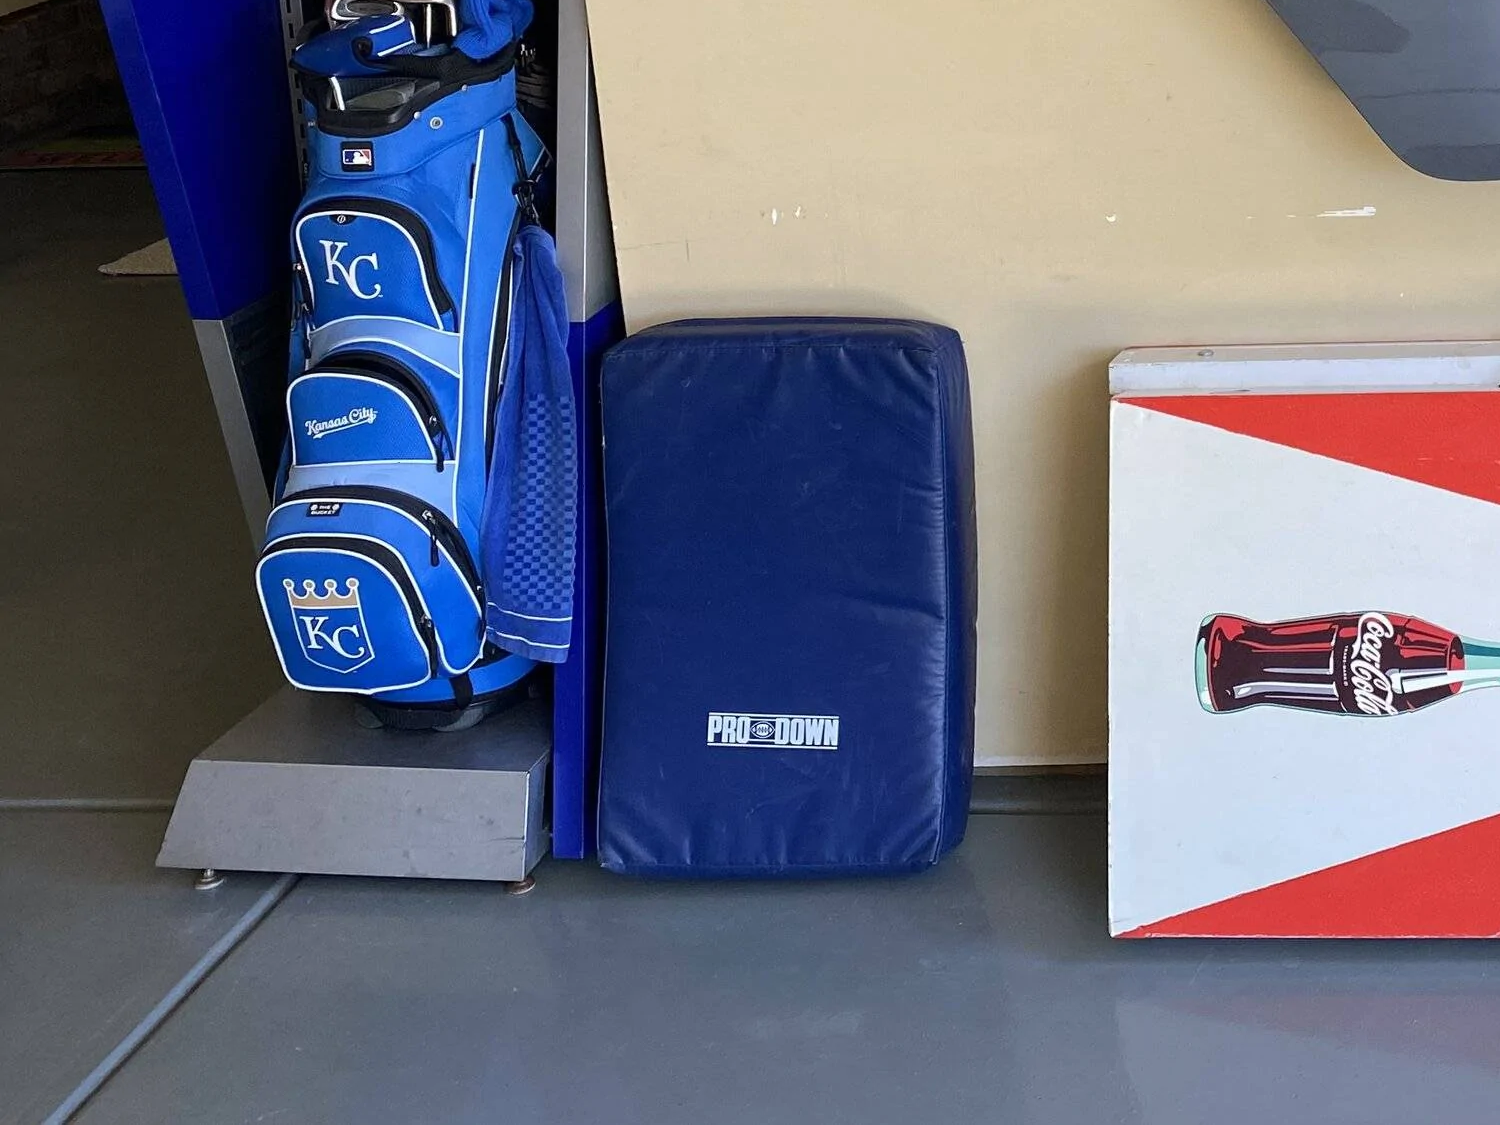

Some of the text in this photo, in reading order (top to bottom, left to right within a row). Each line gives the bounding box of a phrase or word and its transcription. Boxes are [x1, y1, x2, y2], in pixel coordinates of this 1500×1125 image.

[319, 239, 381, 300] KC
[305, 406, 377, 436] Kansas City
[299, 615, 365, 659] KC
[1350, 612, 1399, 715] Coca-Cola
[707, 715, 839, 746] PRO DOWN
